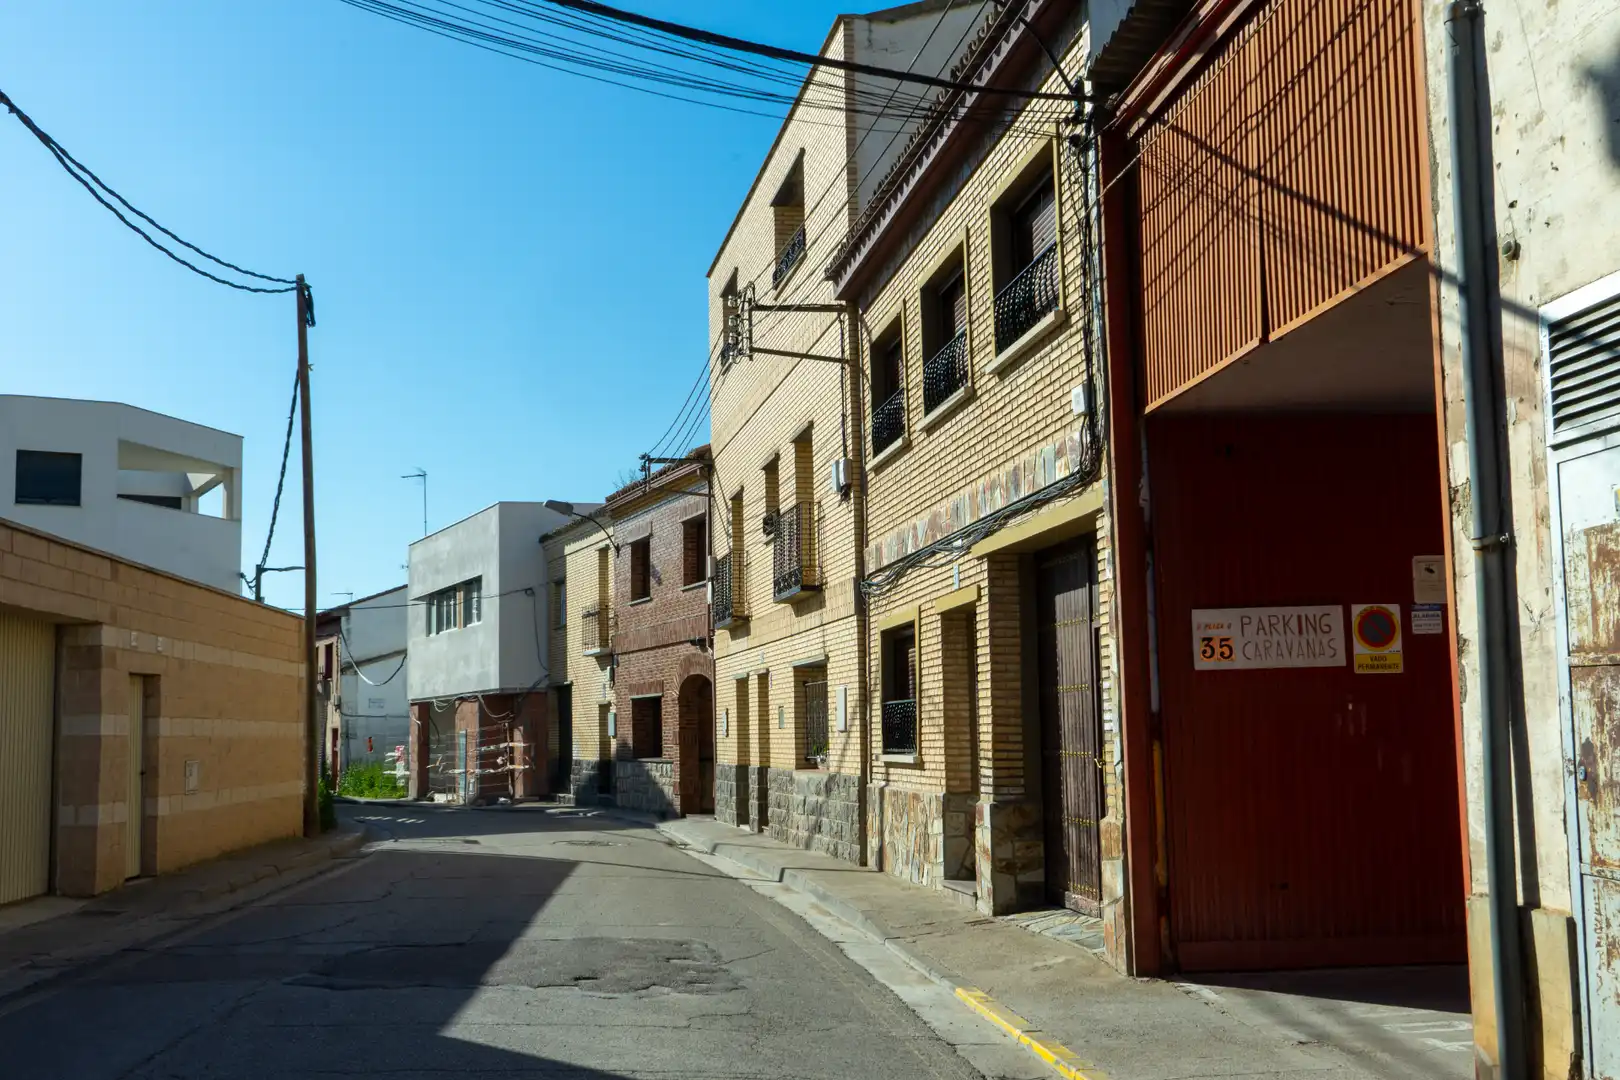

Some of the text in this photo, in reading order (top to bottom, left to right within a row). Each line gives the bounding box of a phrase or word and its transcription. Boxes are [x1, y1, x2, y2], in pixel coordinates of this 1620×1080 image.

[1241, 613, 1332, 637] PARKING
[1201, 637, 1234, 660] 35
[1243, 637, 1337, 661] CARAVANAS
[1358, 662, 1399, 671] PERMANENTE
